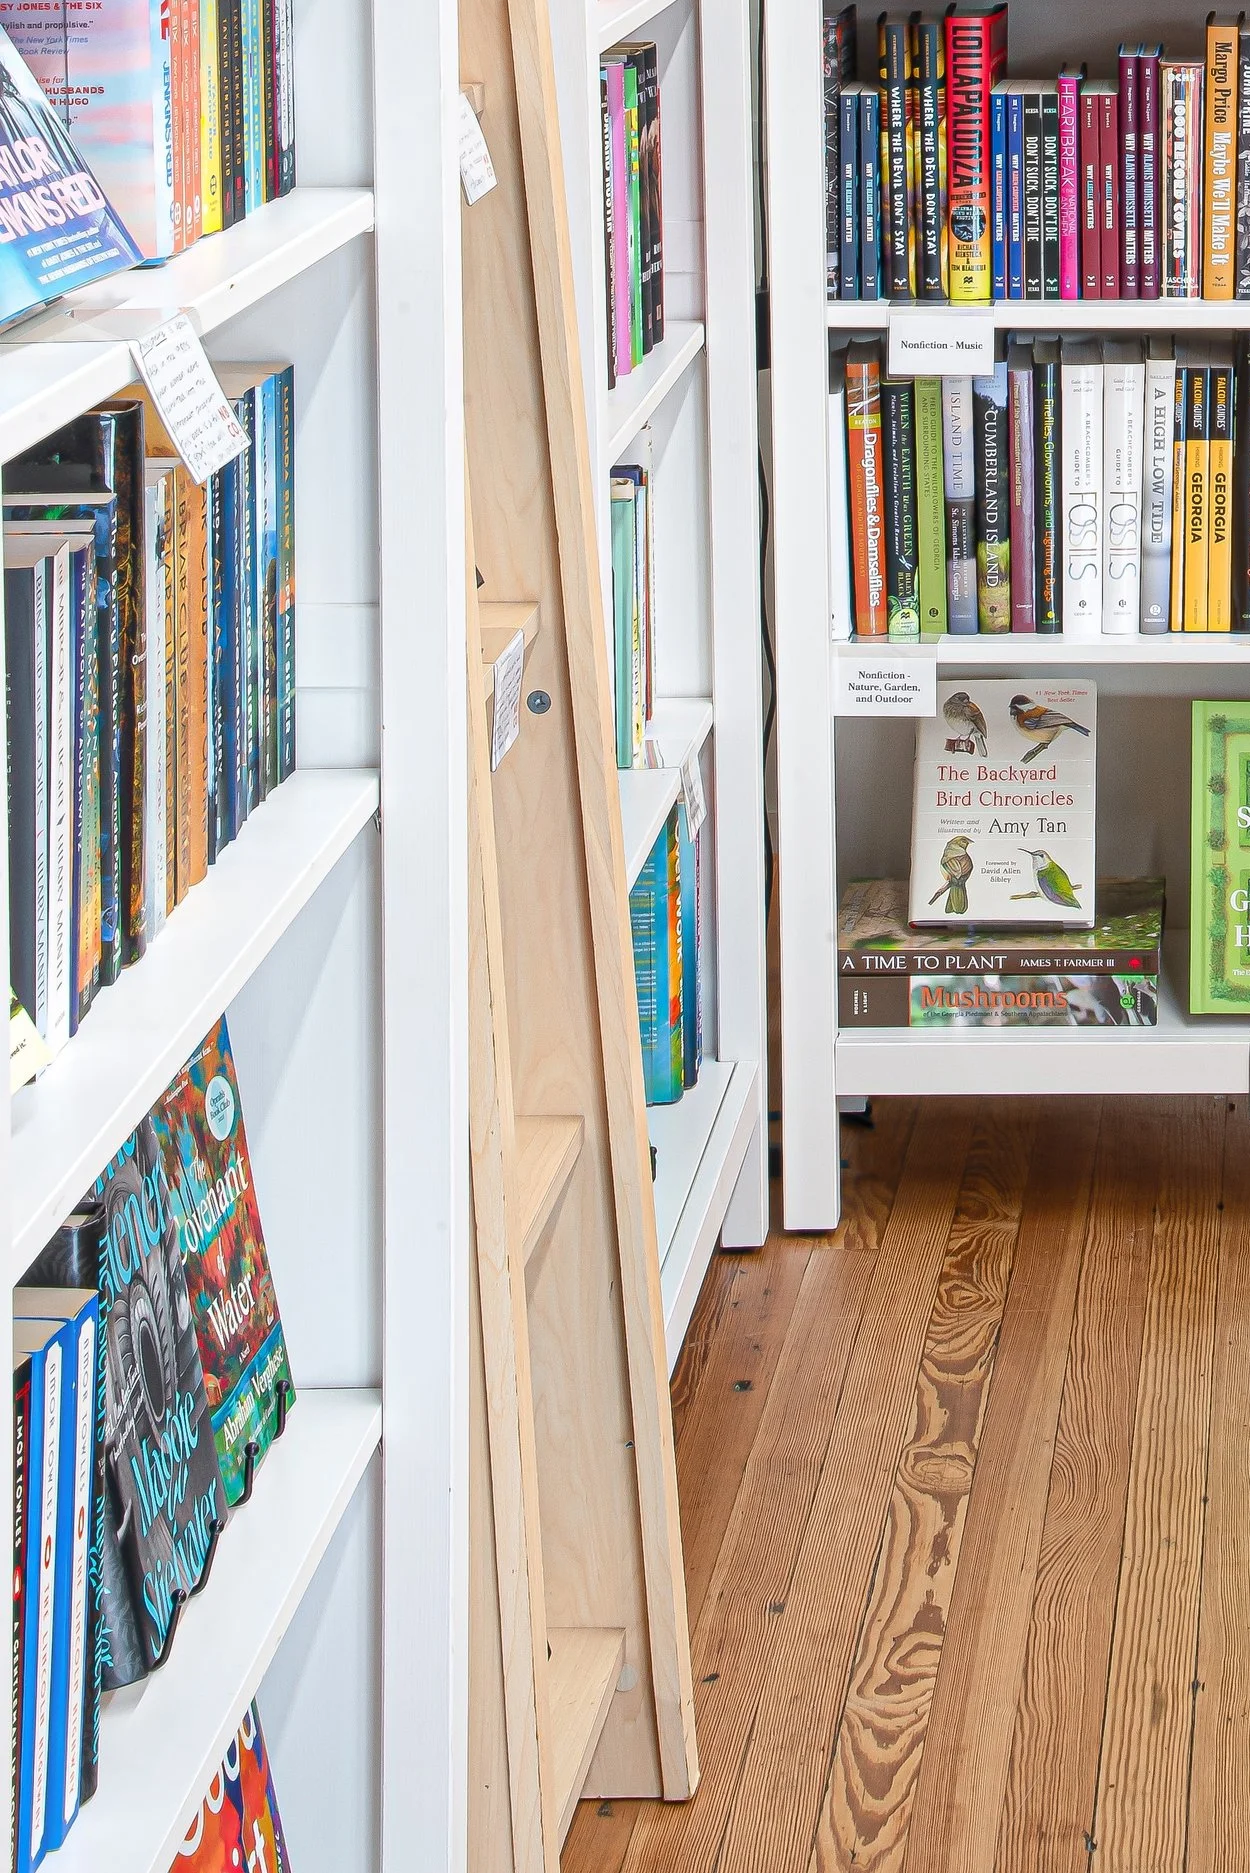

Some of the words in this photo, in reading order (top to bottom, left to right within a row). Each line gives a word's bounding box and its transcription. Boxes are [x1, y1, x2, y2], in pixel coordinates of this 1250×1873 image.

[16, 2, 52, 11] JONES
[53, 2, 61, 11] &
[62, 1, 83, 11] THE
[85, 1, 103, 10] SIX
[1212, 42, 1232, 84] Margo
[950, 26, 983, 188] LOLLAPALOOZA
[1214, 88, 1232, 123] Price
[901, 340, 948, 349] Nonfiction
[956, 340, 983, 350] Music
[984, 410, 998, 523] CUMBERLAND
[1214, 473, 1226, 544] GEORGIA
[986, 529, 999, 587] ISLAND
[858, 671, 903, 680] Nonfiction
[848, 683, 882, 693] Nature,
[884, 683, 921, 693] Garden,
[856, 695, 872, 703] and
[875, 695, 913, 703] Outdoor
[937, 765, 969, 782] The
[977, 765, 1057, 784] Backyard
[936, 791, 972, 807] Bird
[979, 791, 1074, 807] Chronicles
[988, 818, 1029, 837] Amy
[1037, 817, 1067, 833] Tan
[842, 956, 855, 970] A
[862, 956, 908, 970] TIME
[913, 955, 940, 970] TO
[945, 955, 1007, 970] PLANT
[921, 985, 1068, 1009] Mushrooms
[215, 1237, 226, 1278] of
[206, 1273, 258, 1352] Water
